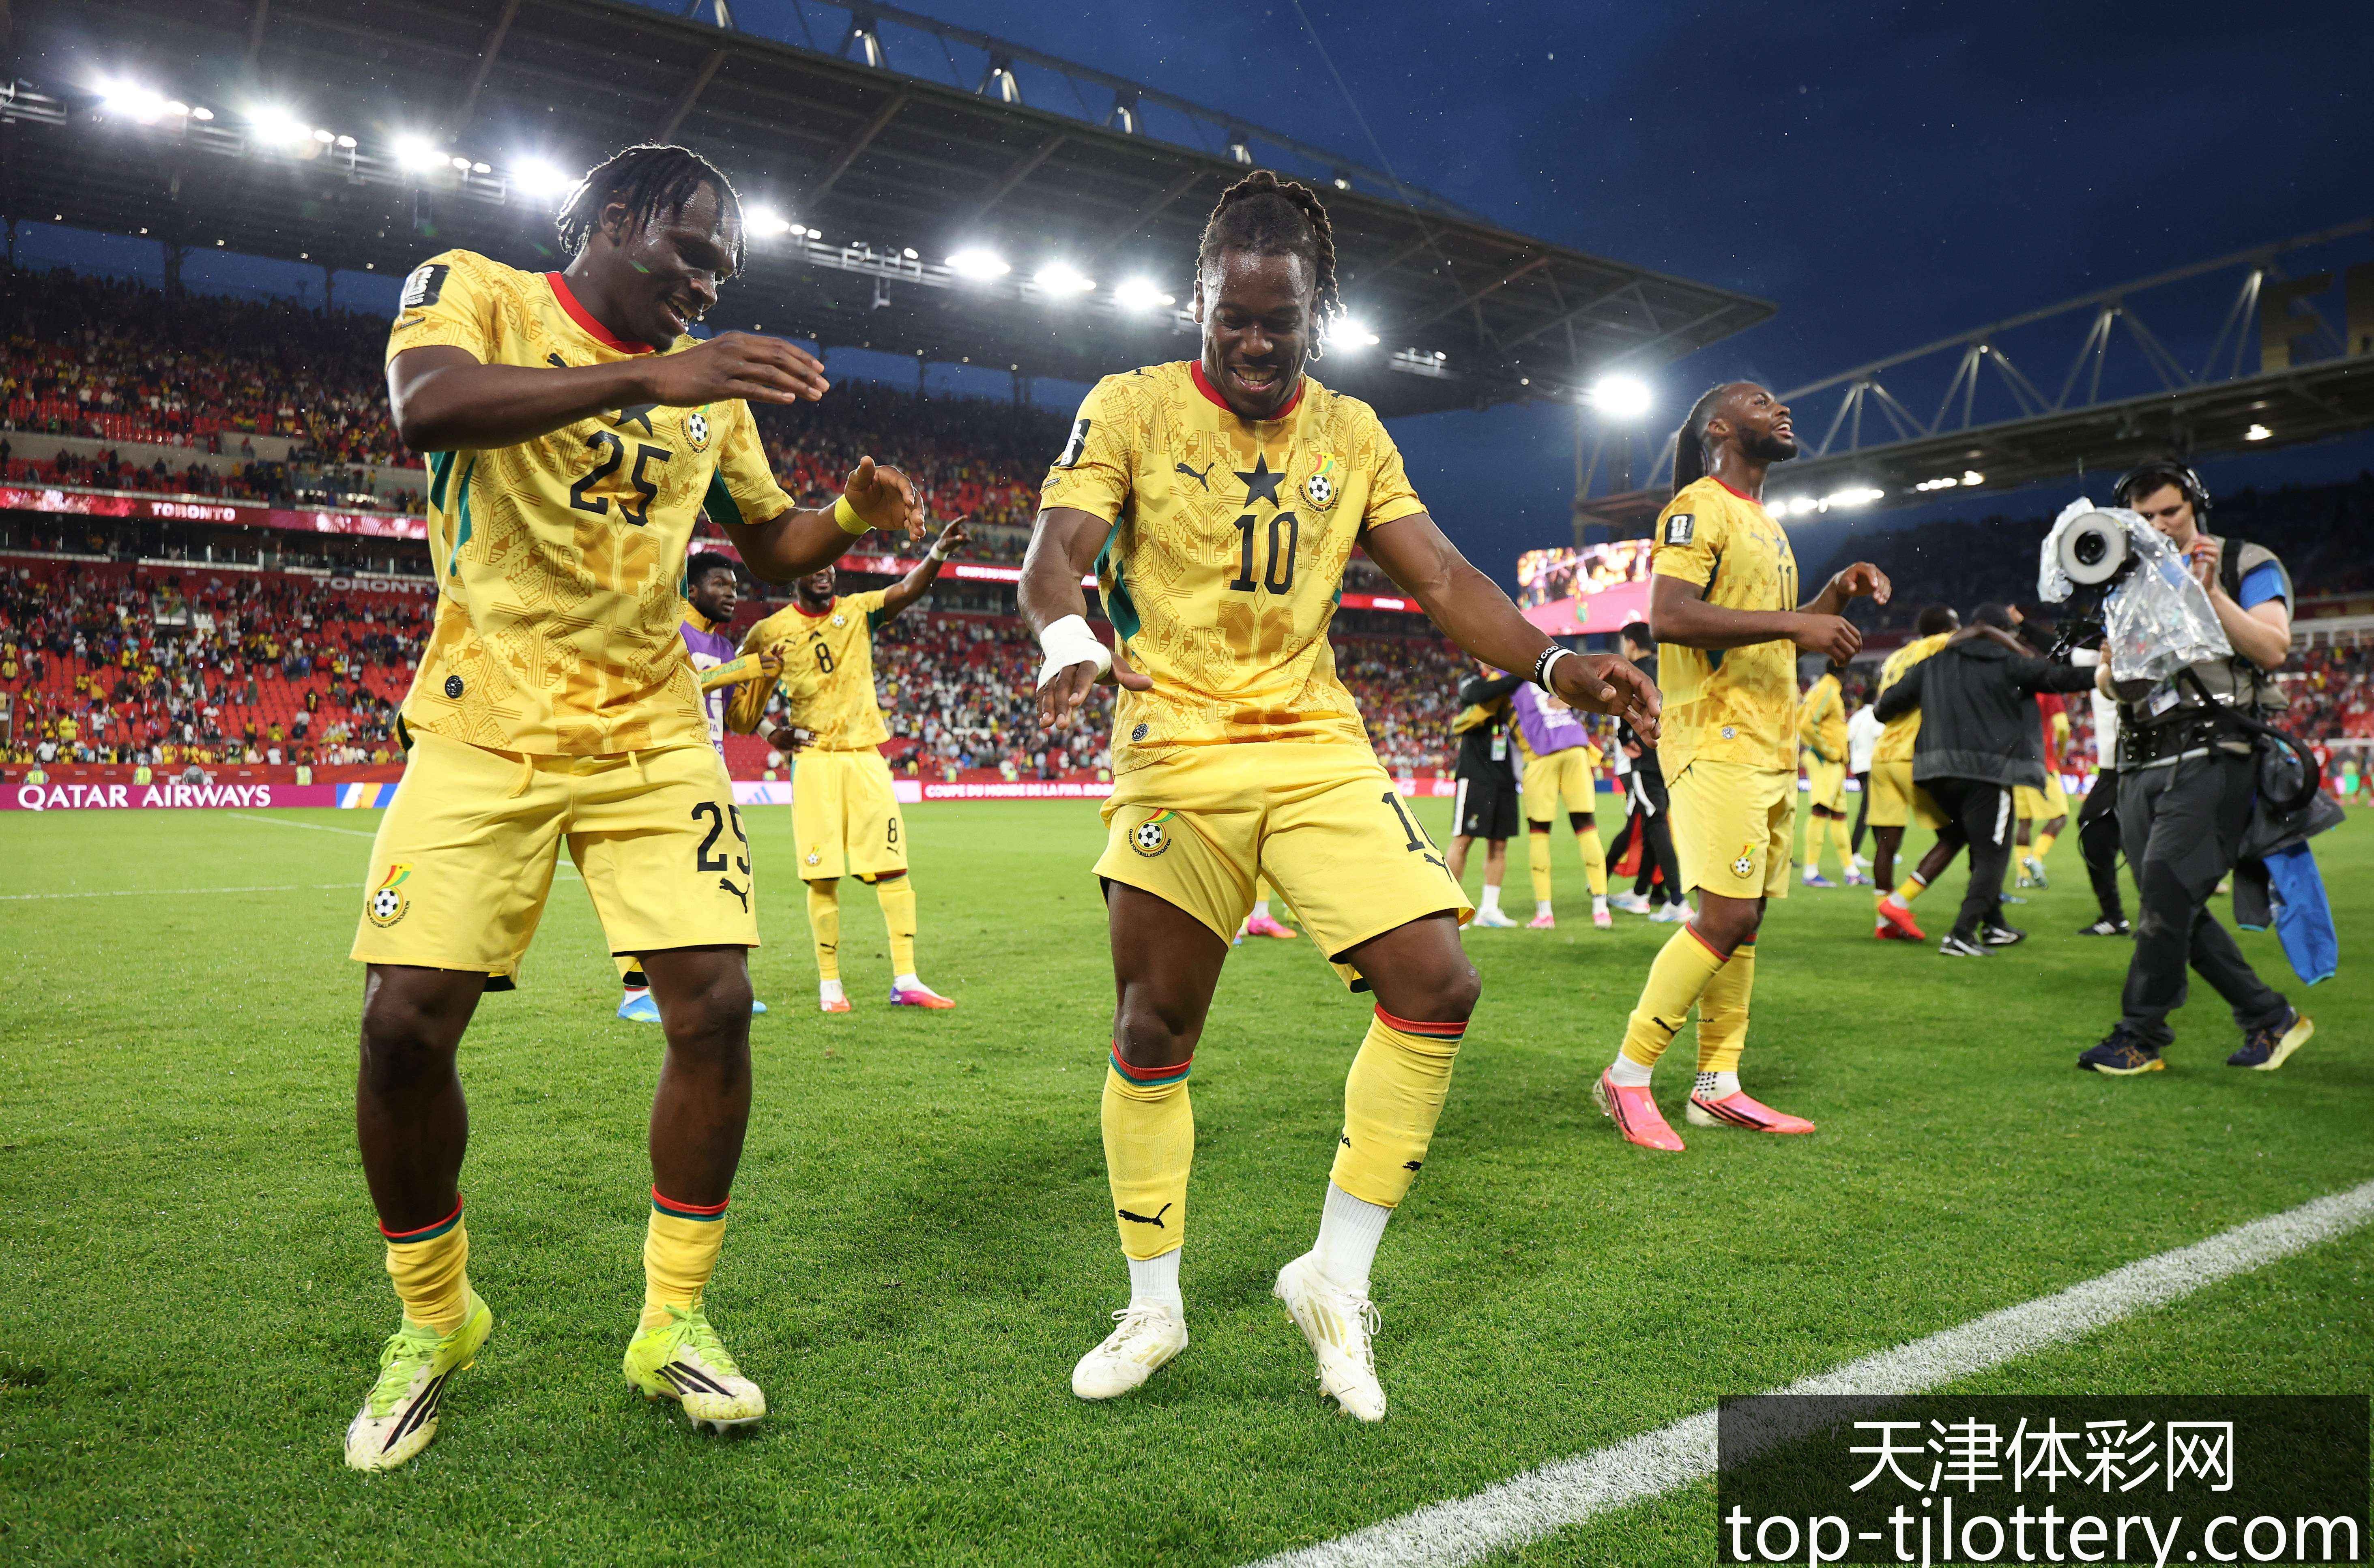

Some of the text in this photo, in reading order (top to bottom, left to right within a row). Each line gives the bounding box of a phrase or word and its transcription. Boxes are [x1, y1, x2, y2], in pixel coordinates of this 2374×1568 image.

[570, 430, 674, 527] 25
[1298, 484, 1306, 501] GHANA
[151, 502, 236, 522] TORONTO
[1229, 511, 1299, 595] 10
[312, 576, 437, 594] TORONT
[815, 643, 834, 674] 8
[1535, 659, 1543, 670] IN
[1540, 646, 1559, 659] GOD
[17, 784, 271, 811] QATAR AIRWAYS
[1042, 783, 1058, 797] LA
[691, 801, 751, 876] 25
[888, 817, 898, 843] 8
[1131, 844, 1150, 857] FOOTBALL
[1149, 838, 1172, 858] ASSOCIATION
